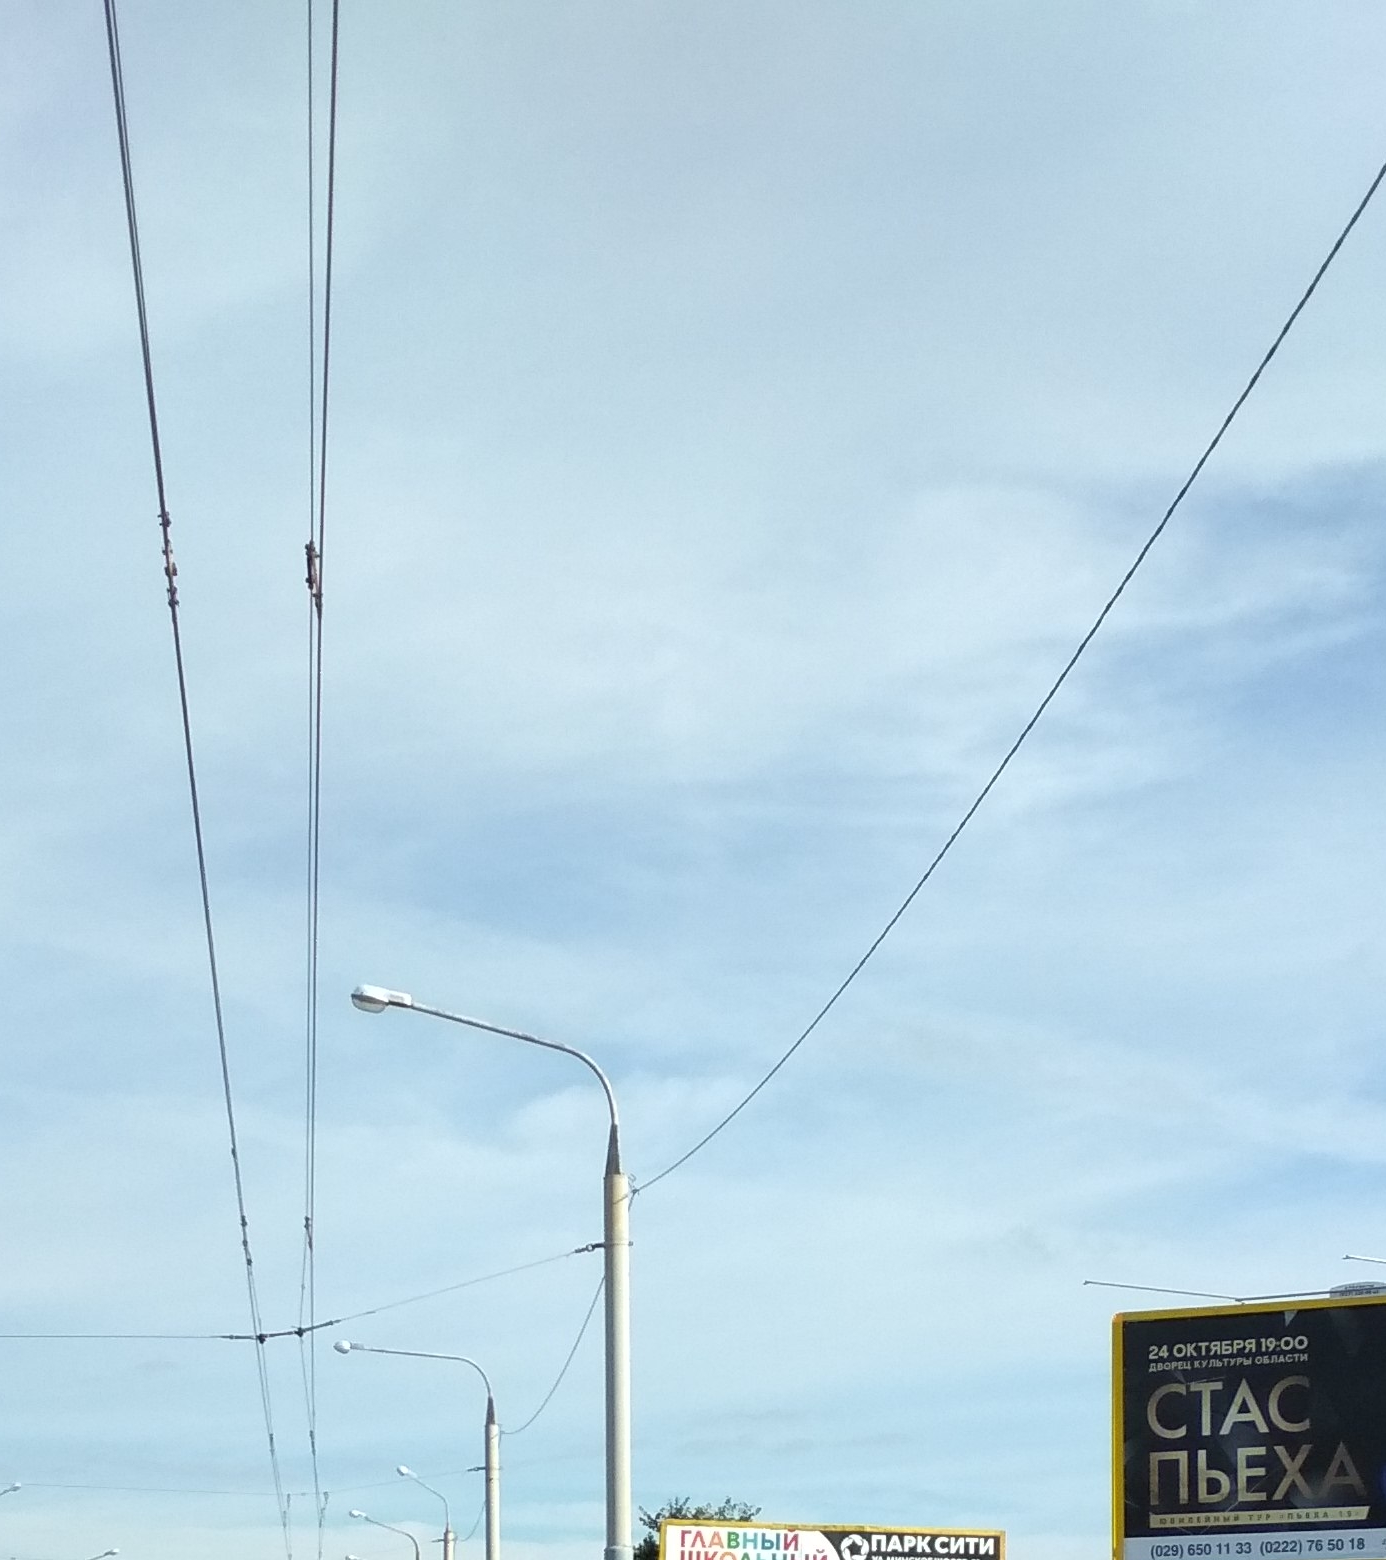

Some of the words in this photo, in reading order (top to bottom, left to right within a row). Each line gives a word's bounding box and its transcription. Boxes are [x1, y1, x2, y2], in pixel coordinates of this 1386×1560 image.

[1148, 1345, 1169, 1359] 24
[1172, 1338, 1256, 1357] ОКТЯБРЯ
[1260, 1336, 1309, 1352] 19:00
[1148, 1361, 1192, 1373] ДВОРЕЦ
[1194, 1356, 1252, 1369] КУЛЬТУРЫ
[1255, 1353, 1309, 1365] ОБЛАСТИ
[1146, 1375, 1311, 1439] СТАС
[1149, 1440, 1368, 1506] ПЬЕХА
[680, 1528, 799, 1551] ГЛАВНЫЙ
[871, 1534, 931, 1553] ПАРК
[934, 1536, 995, 1555] СИТИ
[1150, 1543, 1184, 1560] (029)
[1187, 1543, 1212, 1556] 650
[1215, 1542, 1230, 1555] 11
[1235, 1541, 1253, 1555] 33
[1259, 1539, 1303, 1557] (0222)
[1306, 1538, 1323, 1552] 76
[1327, 1538, 1345, 1551] 50
[1348, 1537, 1366, 1550] 18
